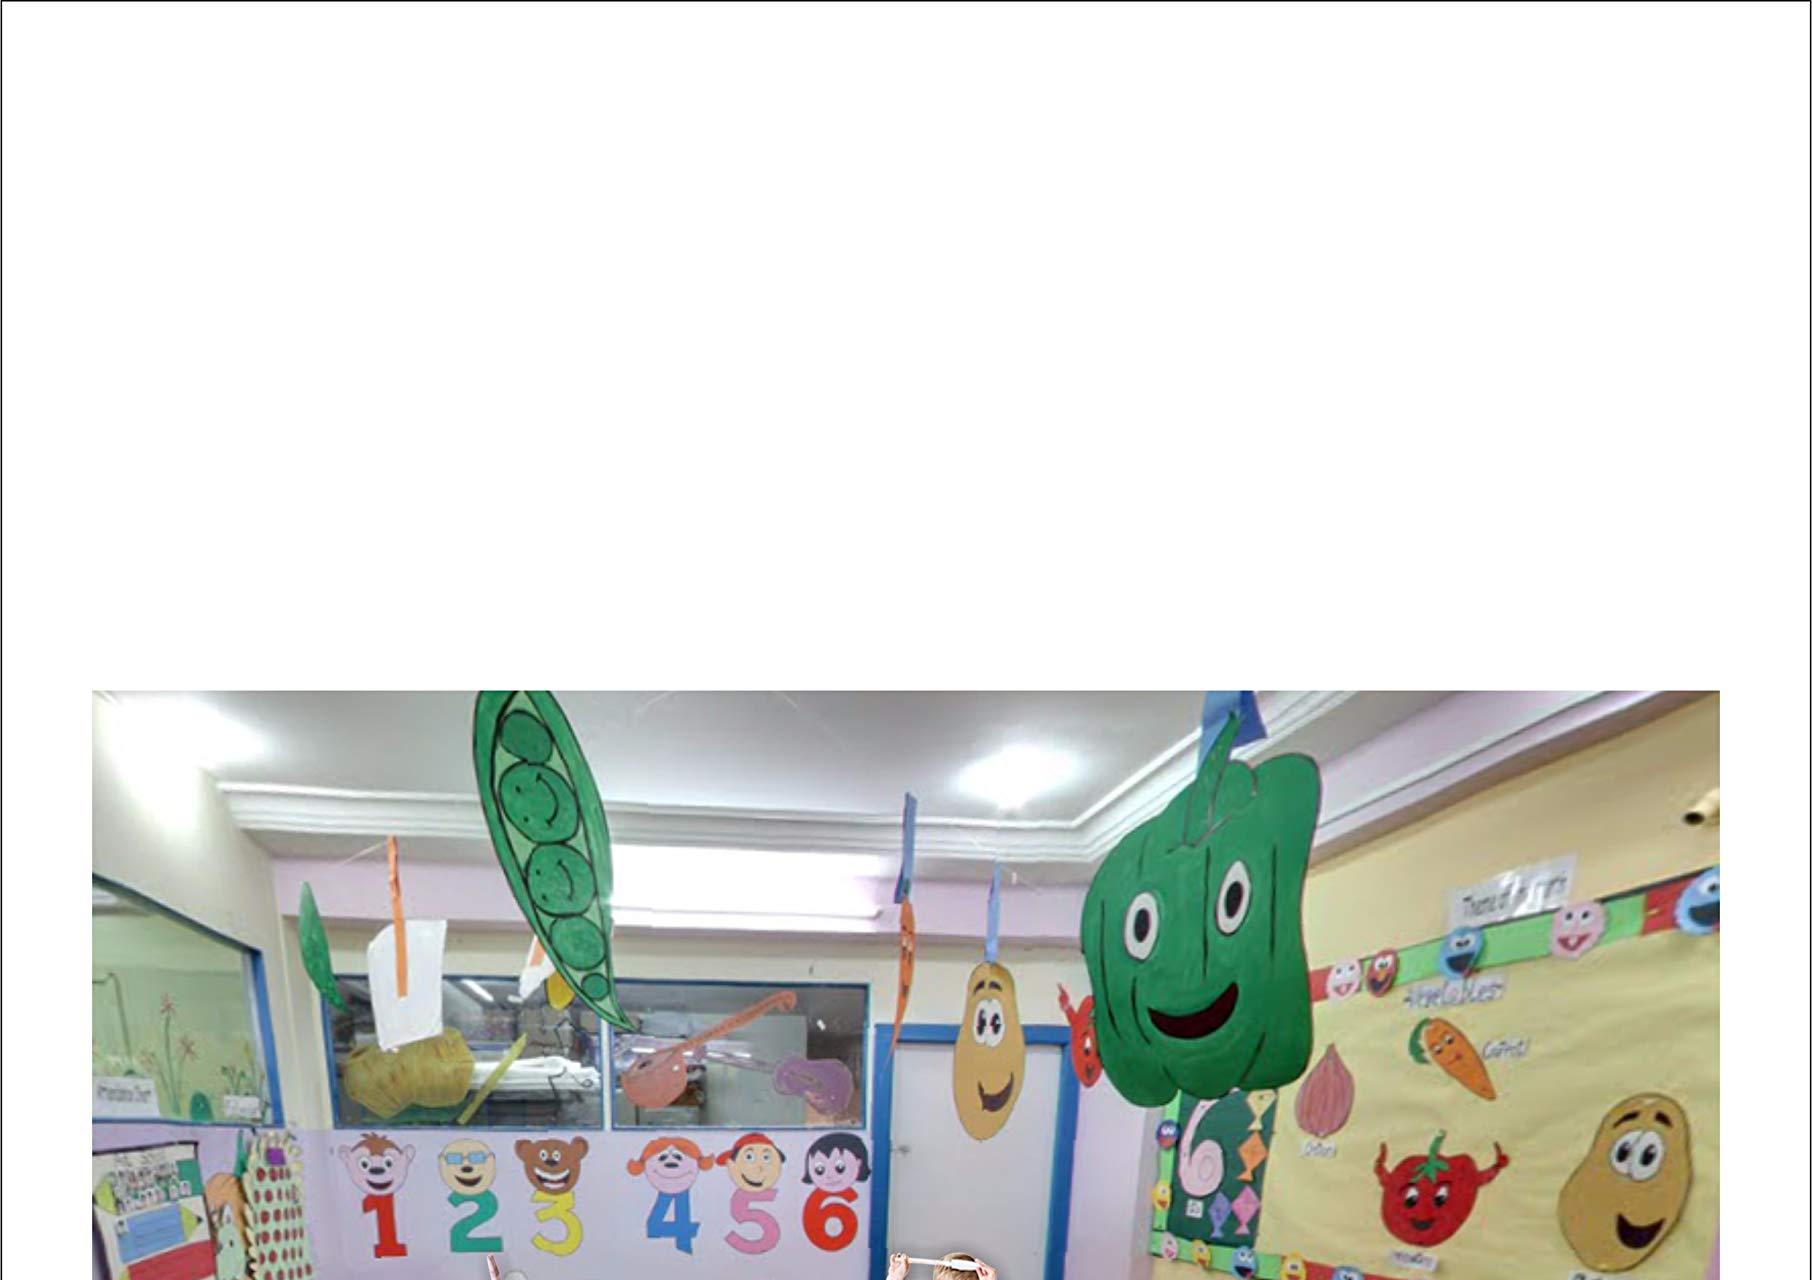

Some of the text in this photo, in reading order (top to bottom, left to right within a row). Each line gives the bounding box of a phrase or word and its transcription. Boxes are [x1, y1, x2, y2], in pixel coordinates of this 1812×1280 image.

[362, 1193, 408, 1259] 1
[447, 1189, 504, 1252] 2
[530, 1190, 584, 1257] 3
[646, 1188, 701, 1255] 4
[724, 1188, 781, 1255] 5
[802, 1186, 859, 1253] 6
